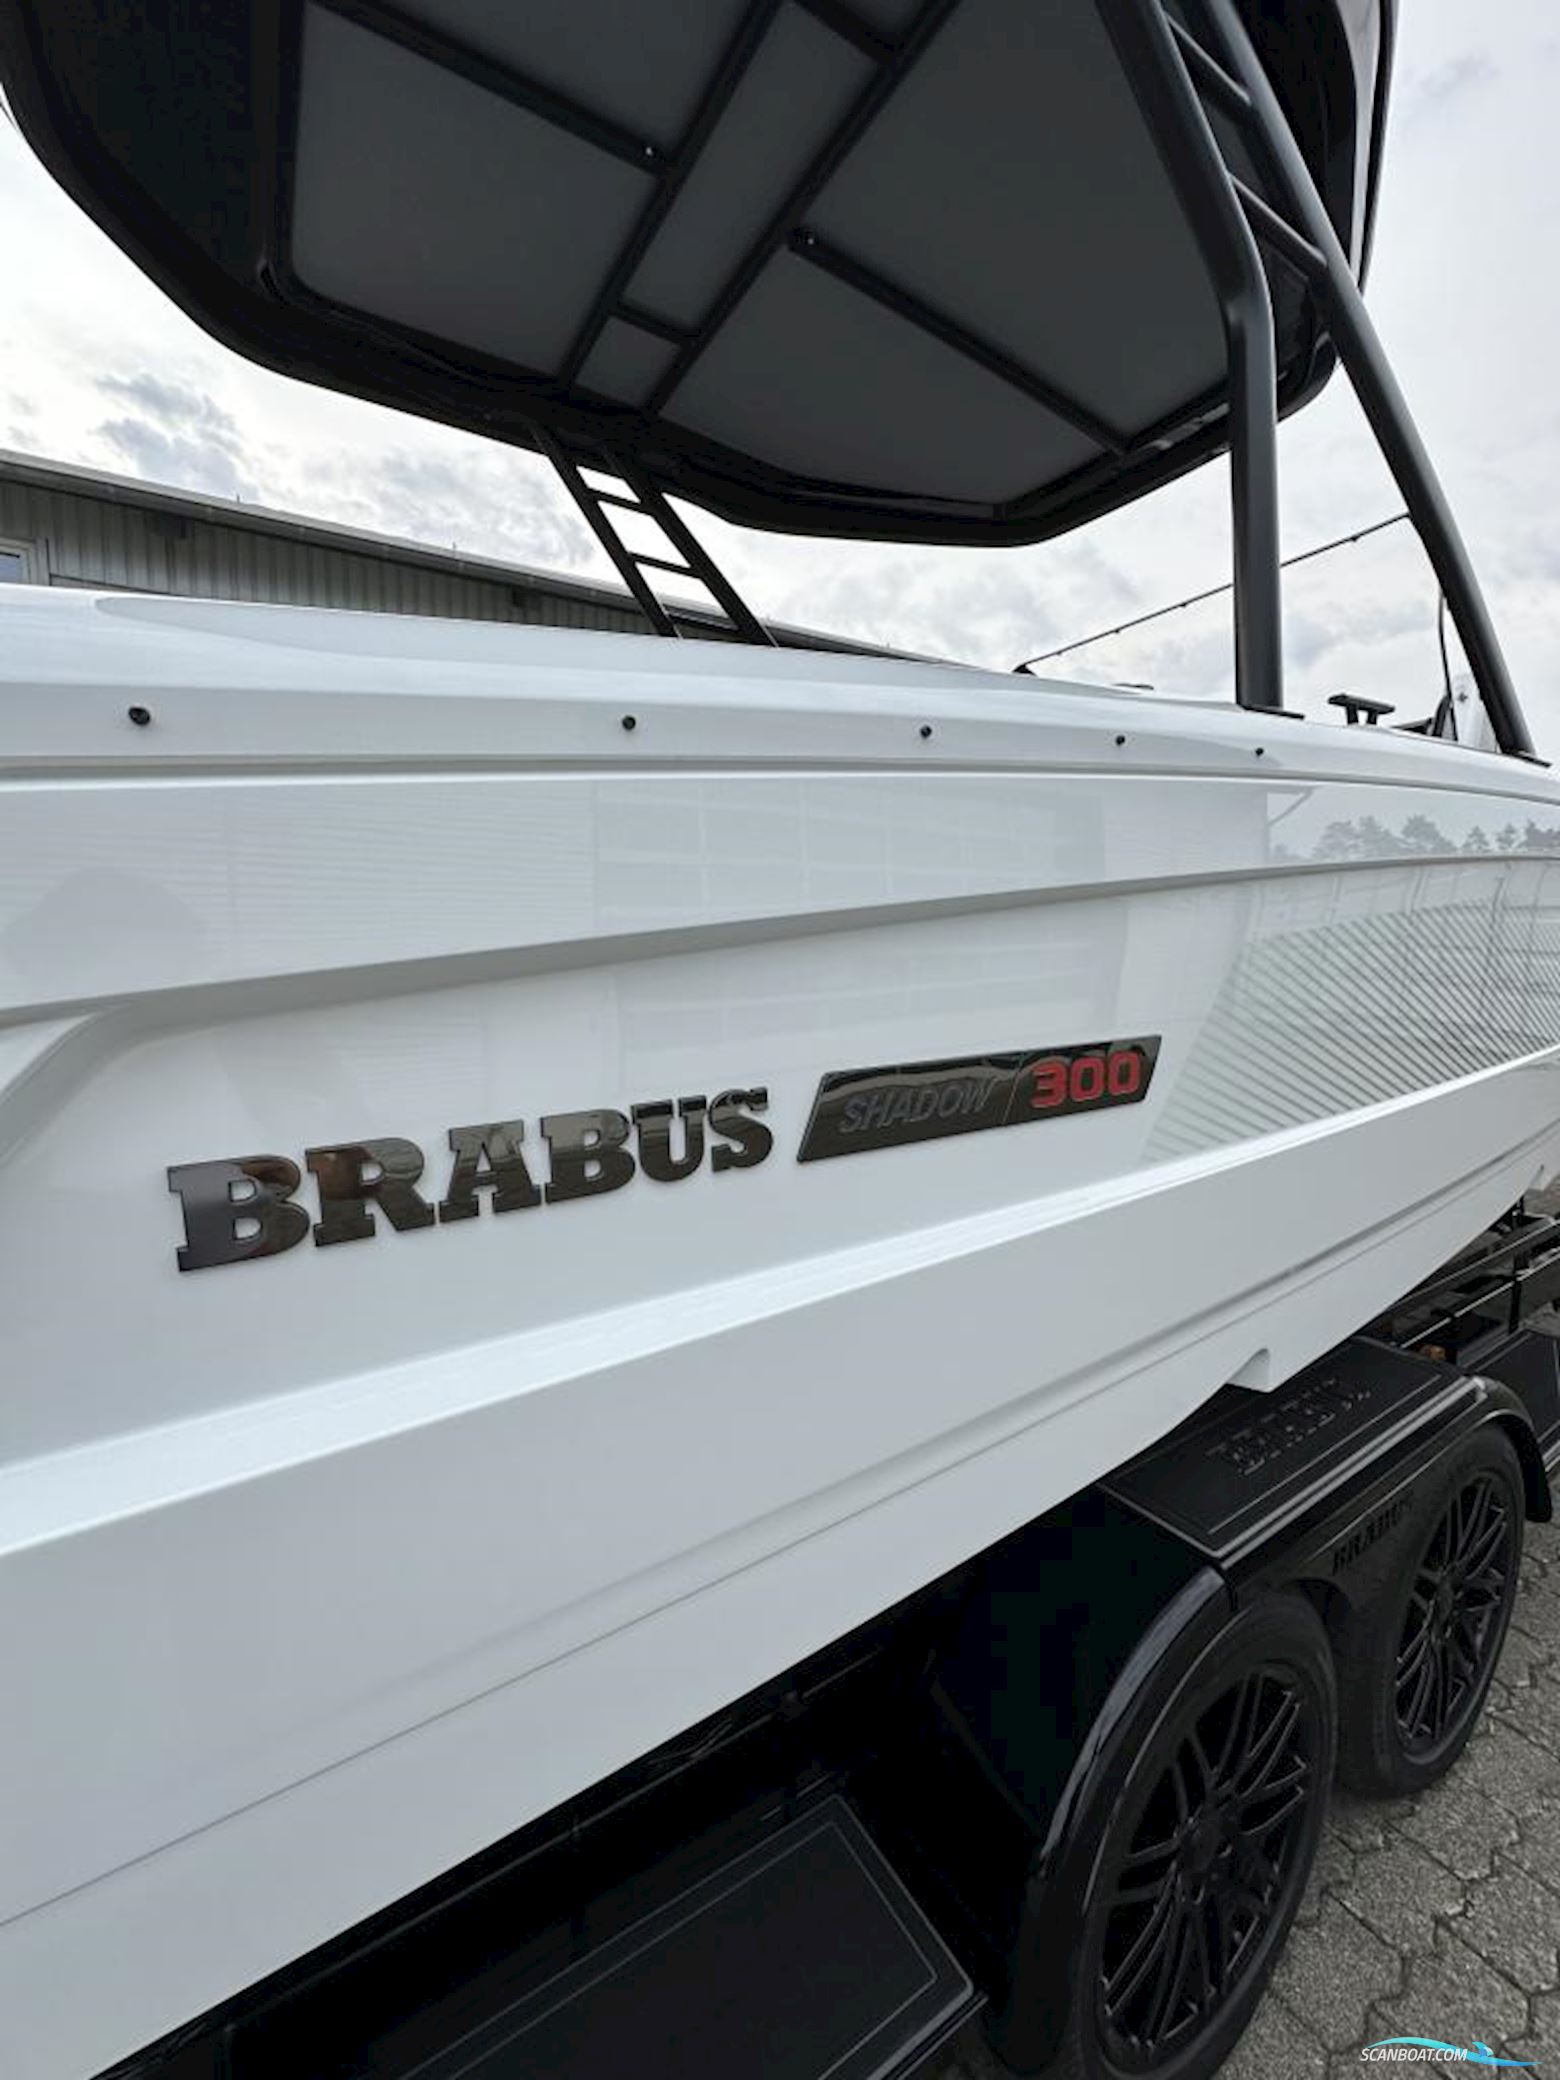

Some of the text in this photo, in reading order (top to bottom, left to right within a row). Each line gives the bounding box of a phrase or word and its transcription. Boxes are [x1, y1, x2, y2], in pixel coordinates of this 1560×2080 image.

[840, 1051, 1141, 1133] SHADOW 300
[166, 1087, 773, 1272] BRABUS
